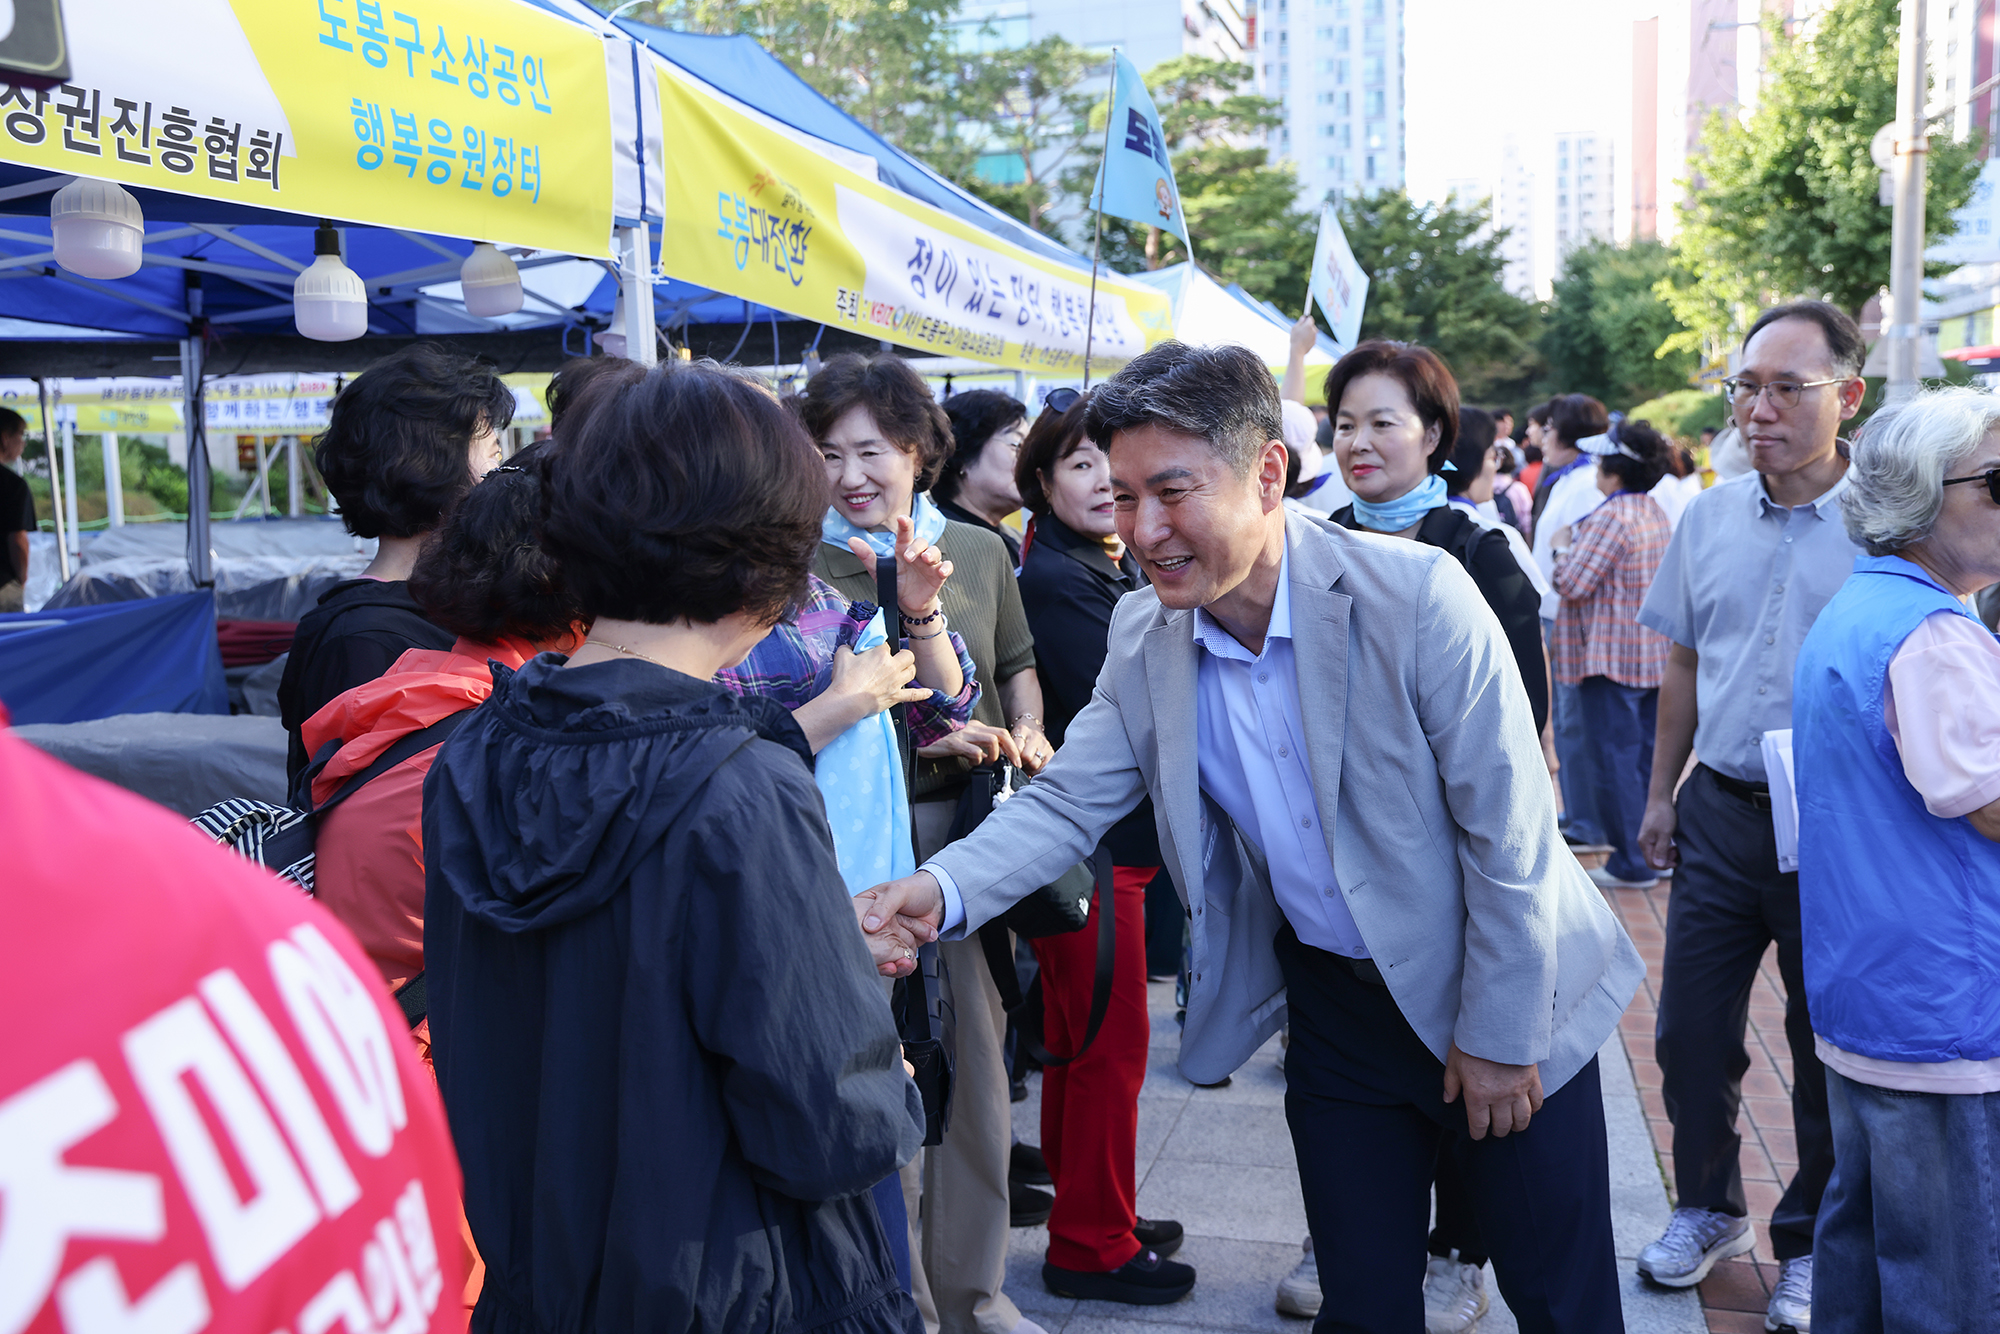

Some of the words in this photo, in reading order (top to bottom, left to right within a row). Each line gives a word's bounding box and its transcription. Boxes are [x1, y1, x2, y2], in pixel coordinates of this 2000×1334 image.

[318, 0, 552, 115] 도봉구소상공인
[0, 84, 283, 190] 상권진흥협회
[350, 97, 541, 204] 행복응원장터
[717, 190, 812, 287] 도봉대전환
[907, 236, 958, 307] 정이
[964, 257, 1006, 319] 있는
[836, 288, 859, 325] 주최
